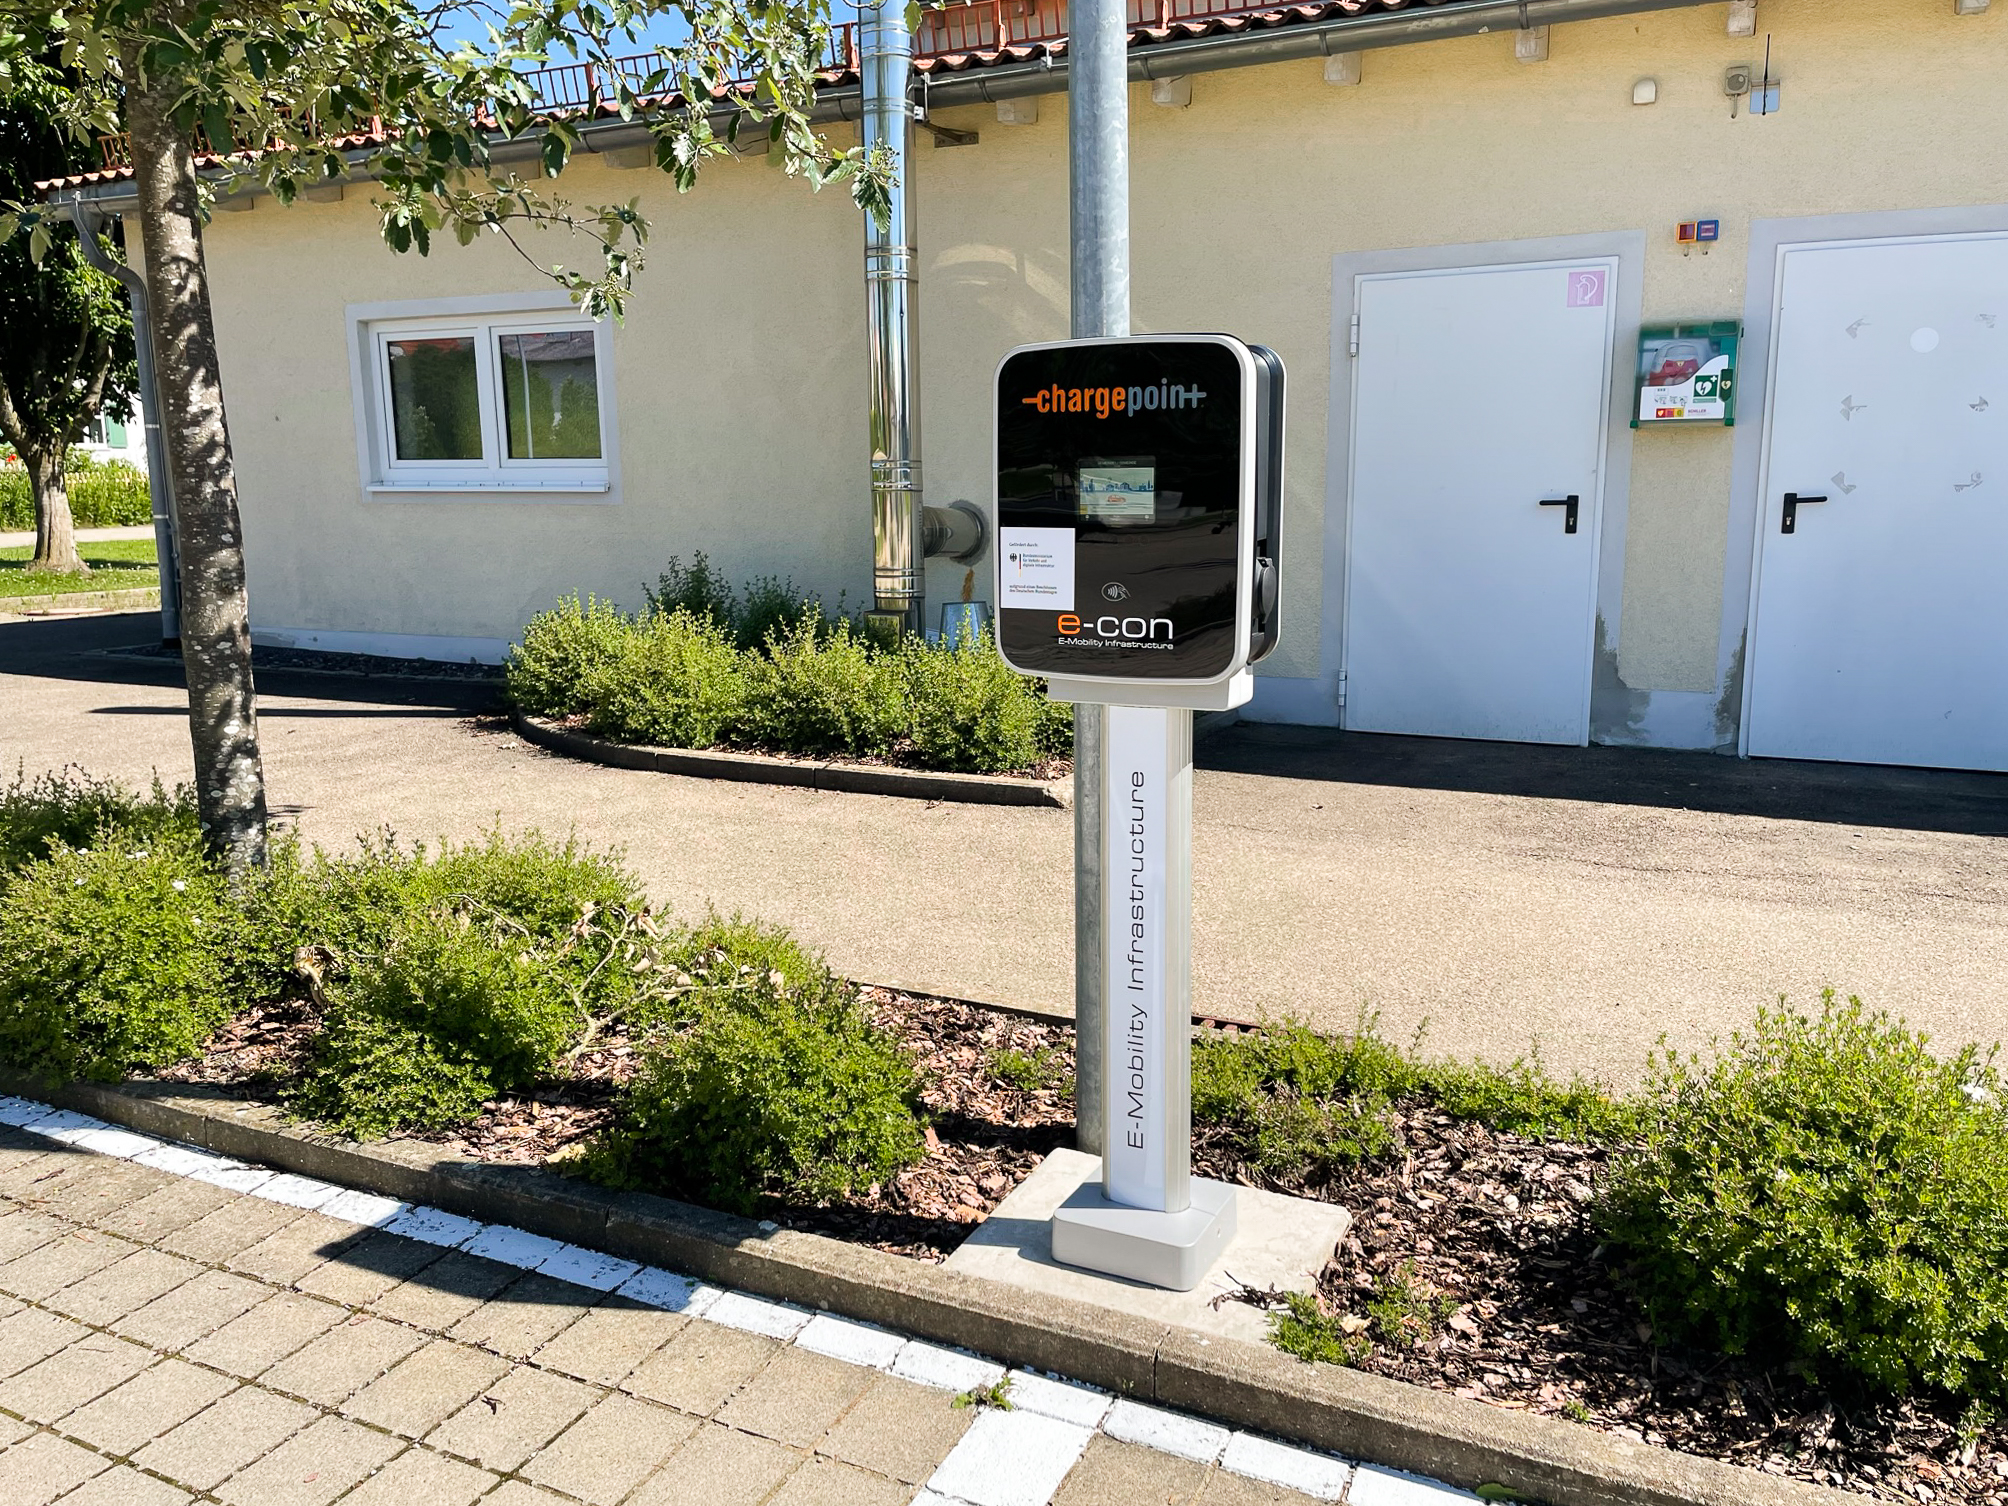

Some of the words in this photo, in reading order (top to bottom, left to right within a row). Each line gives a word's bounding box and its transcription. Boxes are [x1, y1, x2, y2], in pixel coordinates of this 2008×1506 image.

[1057, 614, 1174, 640] e-con
[1058, 637, 1104, 648] E-Mobility
[1105, 639, 1174, 650] Infrastructure
[1127, 771, 1145, 991] Infrastructure
[1127, 1003, 1148, 1149] E-Mobility
